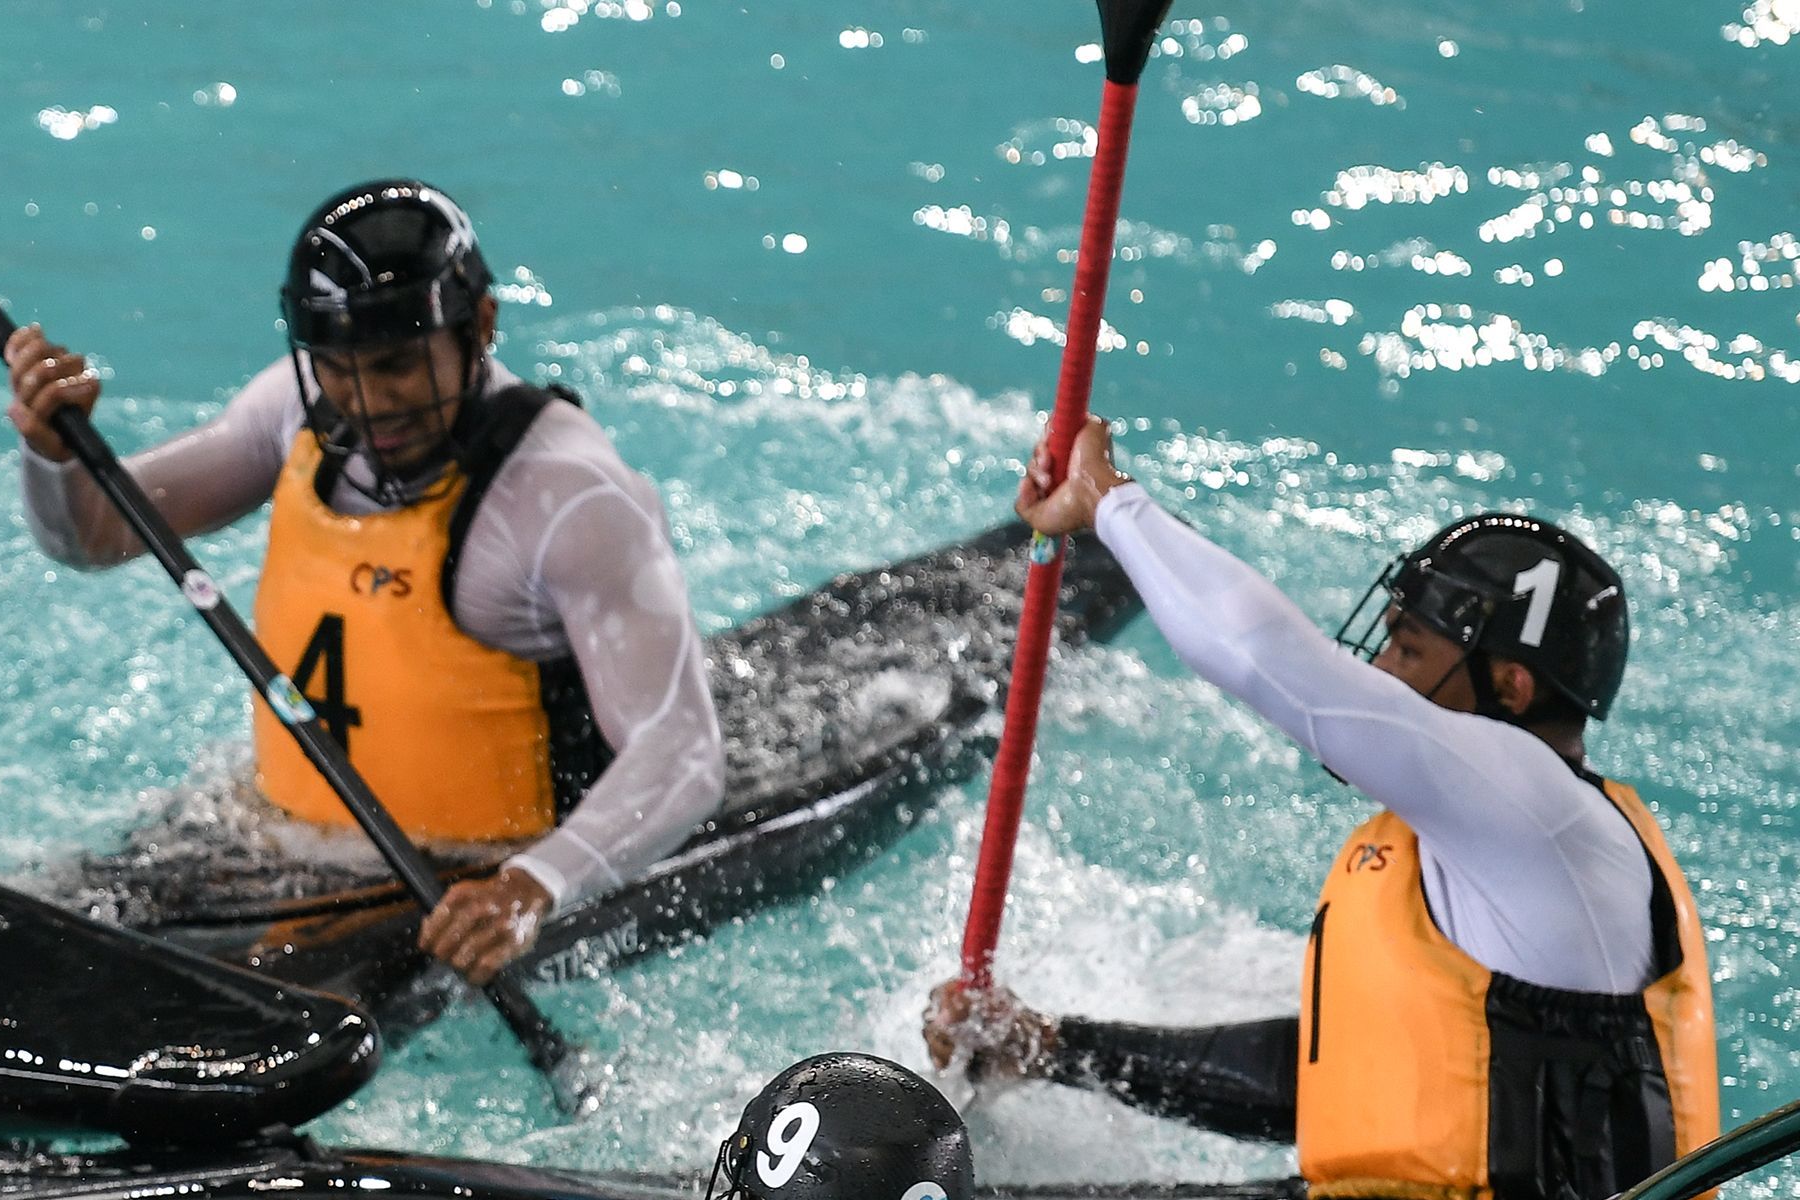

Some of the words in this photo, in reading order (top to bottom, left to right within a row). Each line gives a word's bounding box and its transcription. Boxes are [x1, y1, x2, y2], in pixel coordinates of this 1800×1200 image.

[351, 561, 412, 597] CPS
[1513, 557, 1560, 648] 1
[290, 612, 362, 758] 4
[1346, 843, 1393, 874] CPS
[1309, 901, 1330, 1064] 1
[756, 1101, 821, 1189] 9
